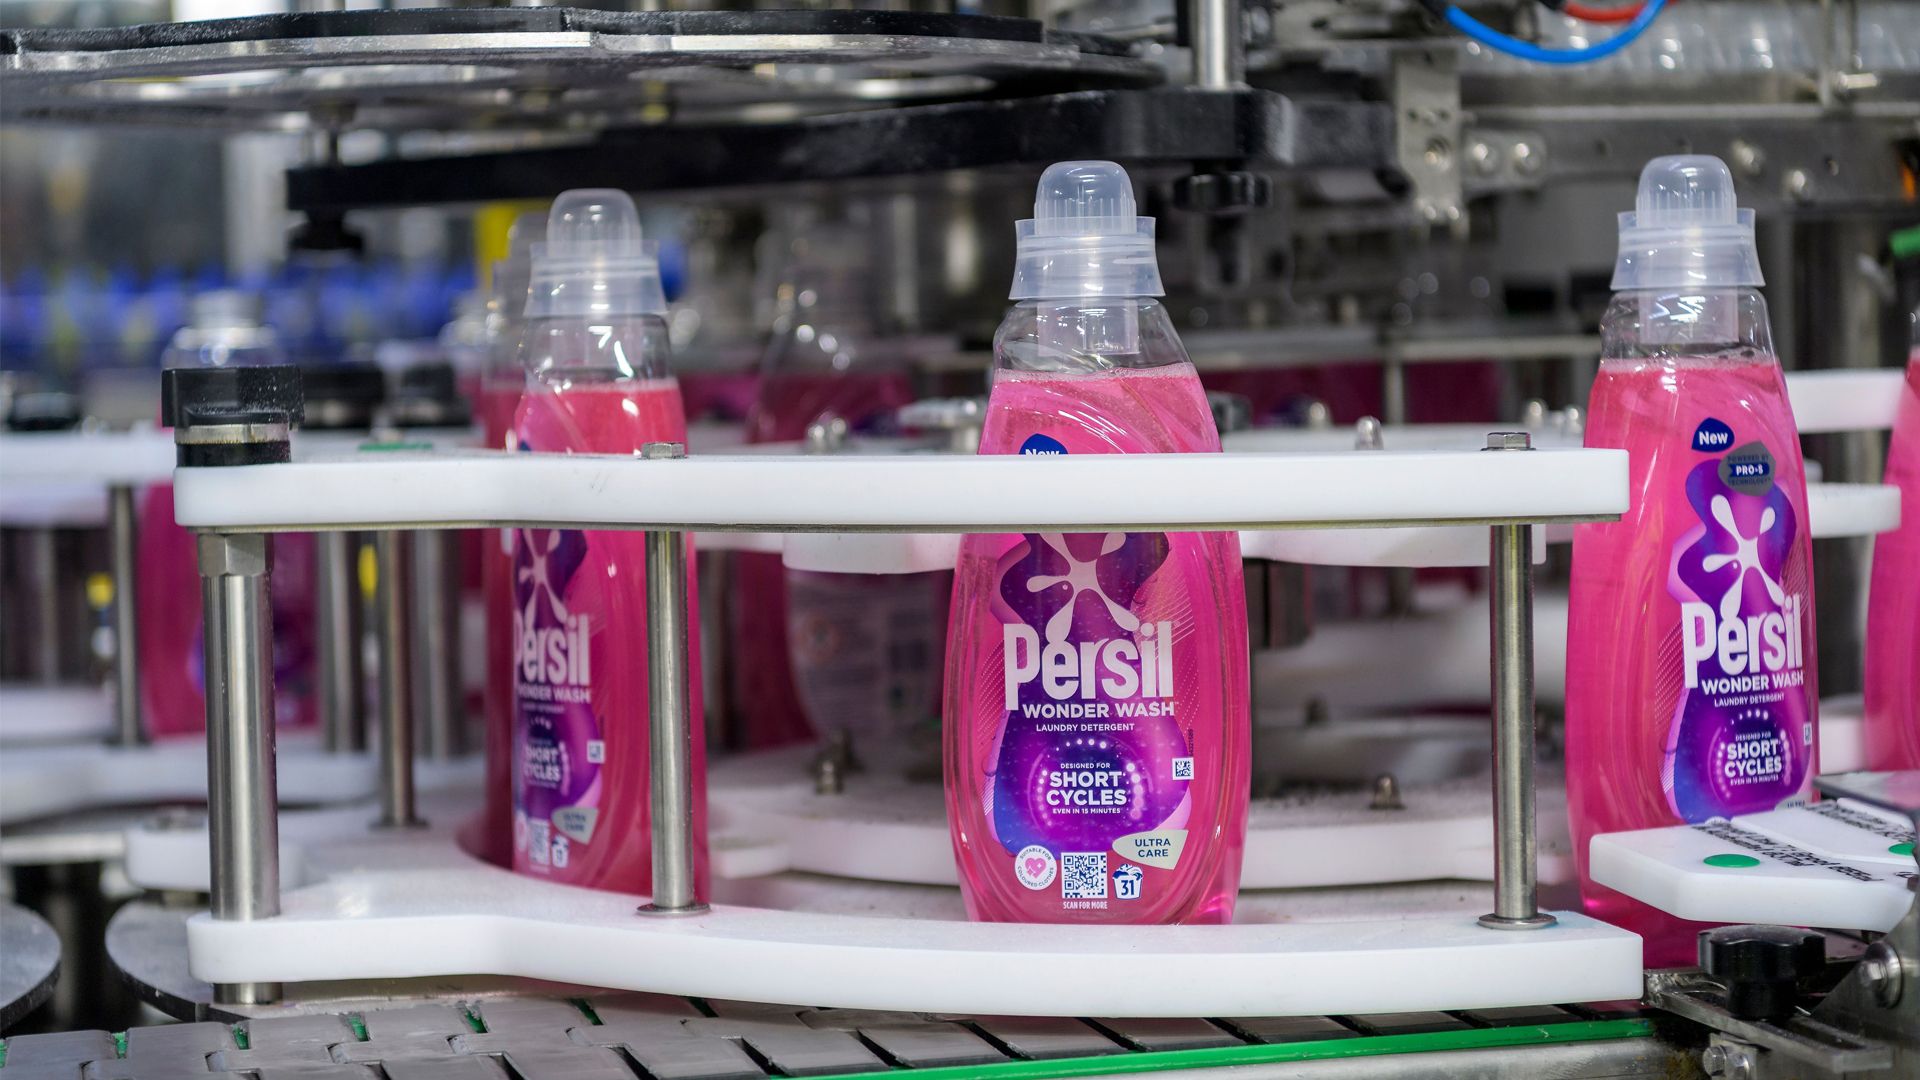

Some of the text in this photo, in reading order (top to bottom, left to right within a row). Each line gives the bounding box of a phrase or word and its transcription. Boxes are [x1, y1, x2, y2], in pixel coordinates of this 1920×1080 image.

[1698, 431, 1728, 445] New
[1682, 594, 1803, 689] Persil
[1003, 621, 1174, 711] Persil
[1702, 671, 1804, 696] WONDER WASH
[1714, 693, 1785, 708] LAUNDRY DETERGENT
[1023, 703, 1175, 719] WONDER WASH
[1036, 723, 1135, 732] LAUNDRY DETERGENT
[1727, 739, 1778, 760] SHORT
[1724, 755, 1783, 778] CYCLES
[1049, 771, 1122, 787] SHORT
[1046, 789, 1127, 806] CYCLES
[1134, 838, 1171, 848] ULTRA
[1137, 848, 1169, 858] CARE
[1120, 879, 1135, 896] 31
[1063, 901, 1108, 910] SCAN FOR MORE
